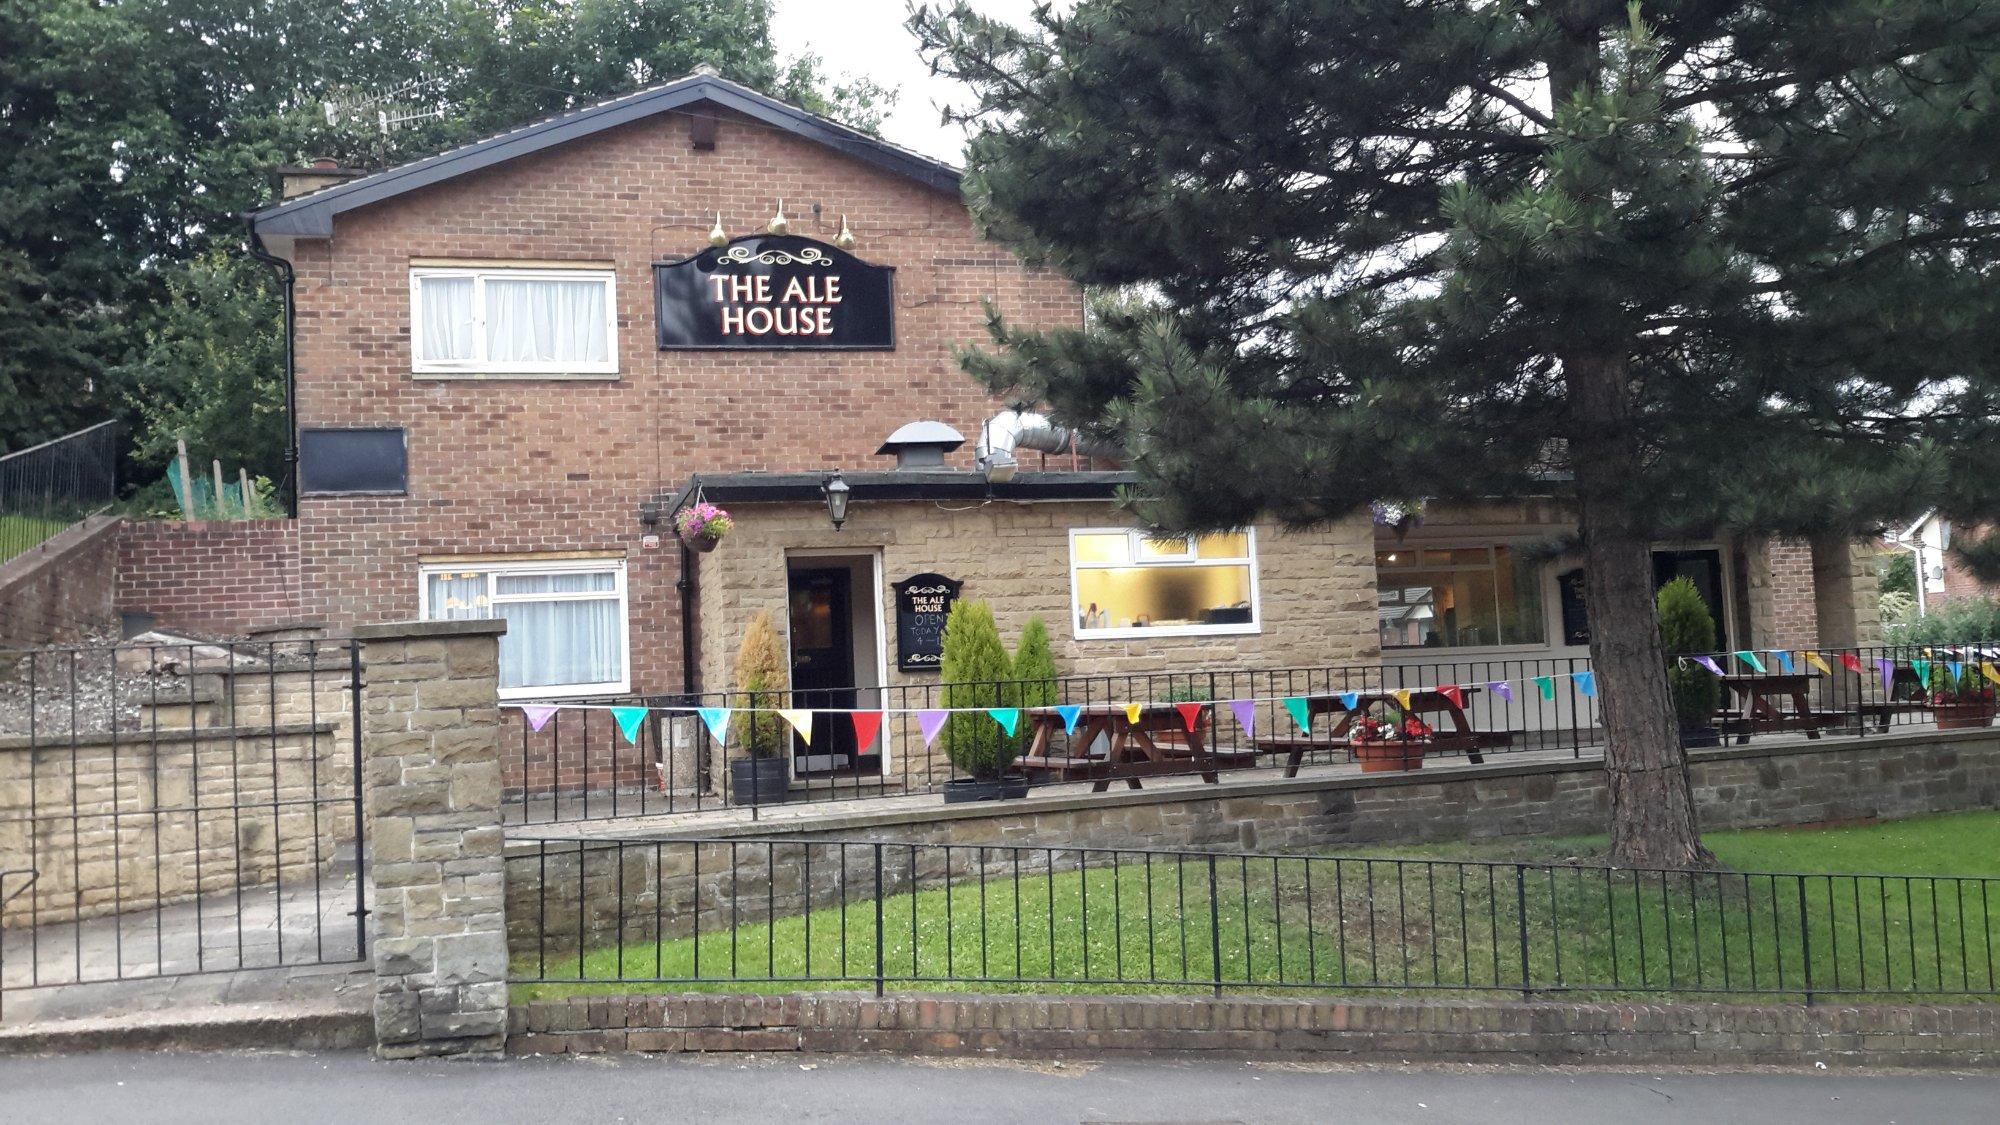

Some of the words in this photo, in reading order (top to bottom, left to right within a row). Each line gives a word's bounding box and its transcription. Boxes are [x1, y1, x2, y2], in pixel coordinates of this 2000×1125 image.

[709, 274, 773, 304] THE
[781, 275, 843, 304] ALE
[720, 307, 834, 336] HOUSE
[912, 596, 927, 604] THE
[930, 596, 944, 604] ALE
[915, 604, 942, 612] HOUSE
[915, 614, 944, 626] OPEN
